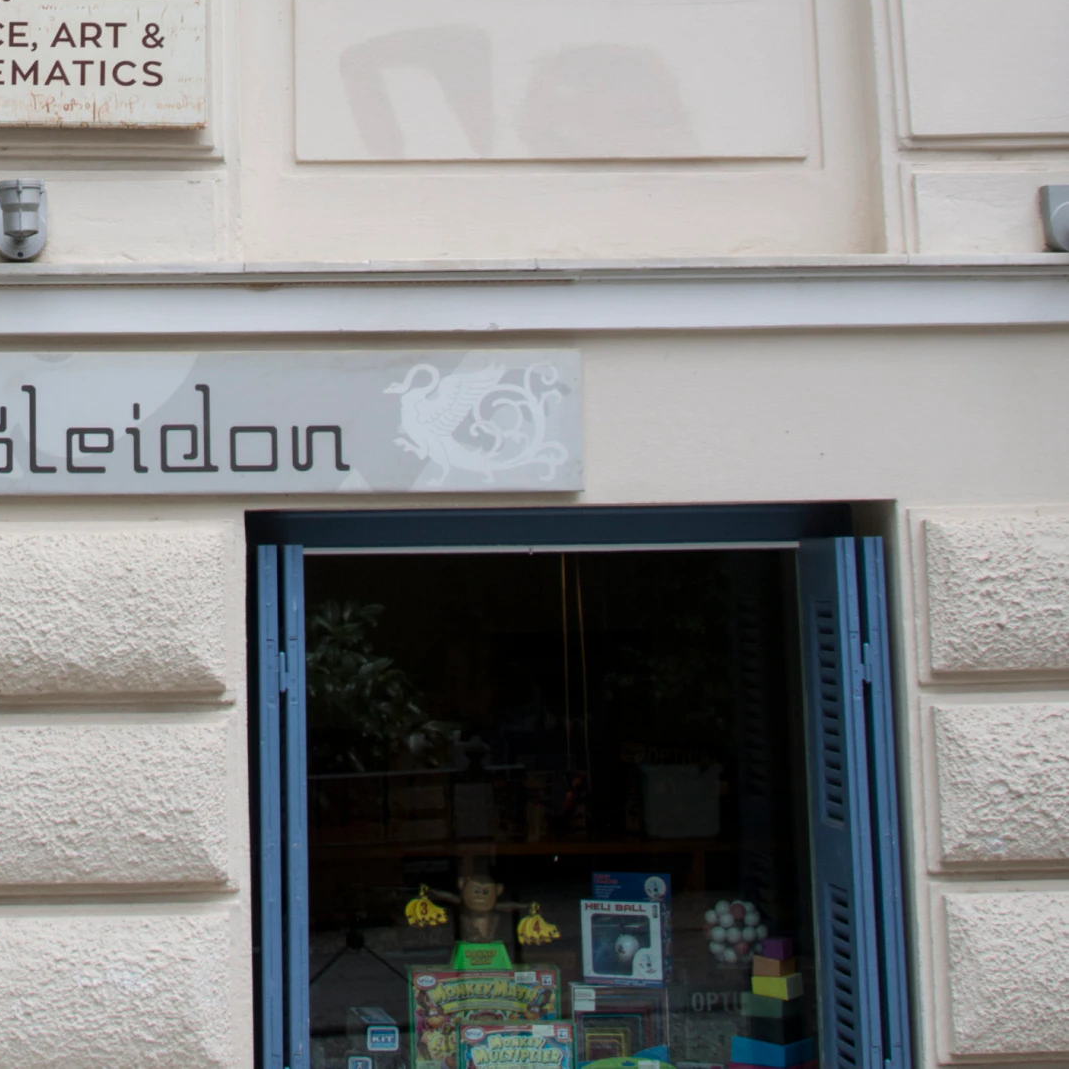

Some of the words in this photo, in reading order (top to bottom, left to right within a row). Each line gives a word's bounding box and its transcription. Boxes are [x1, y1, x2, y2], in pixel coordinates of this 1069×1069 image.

[50, 22, 128, 49] ART
[141, 23, 166, 49] &
[584, 902, 612, 911] HELI
[615, 904, 647, 912] BALL
[430, 981, 494, 1005] MONKEY
[371, 1033, 395, 1042] KIT
[487, 1033, 546, 1049] MONKEY
[471, 1047, 562, 1065] MULTIPLIER
